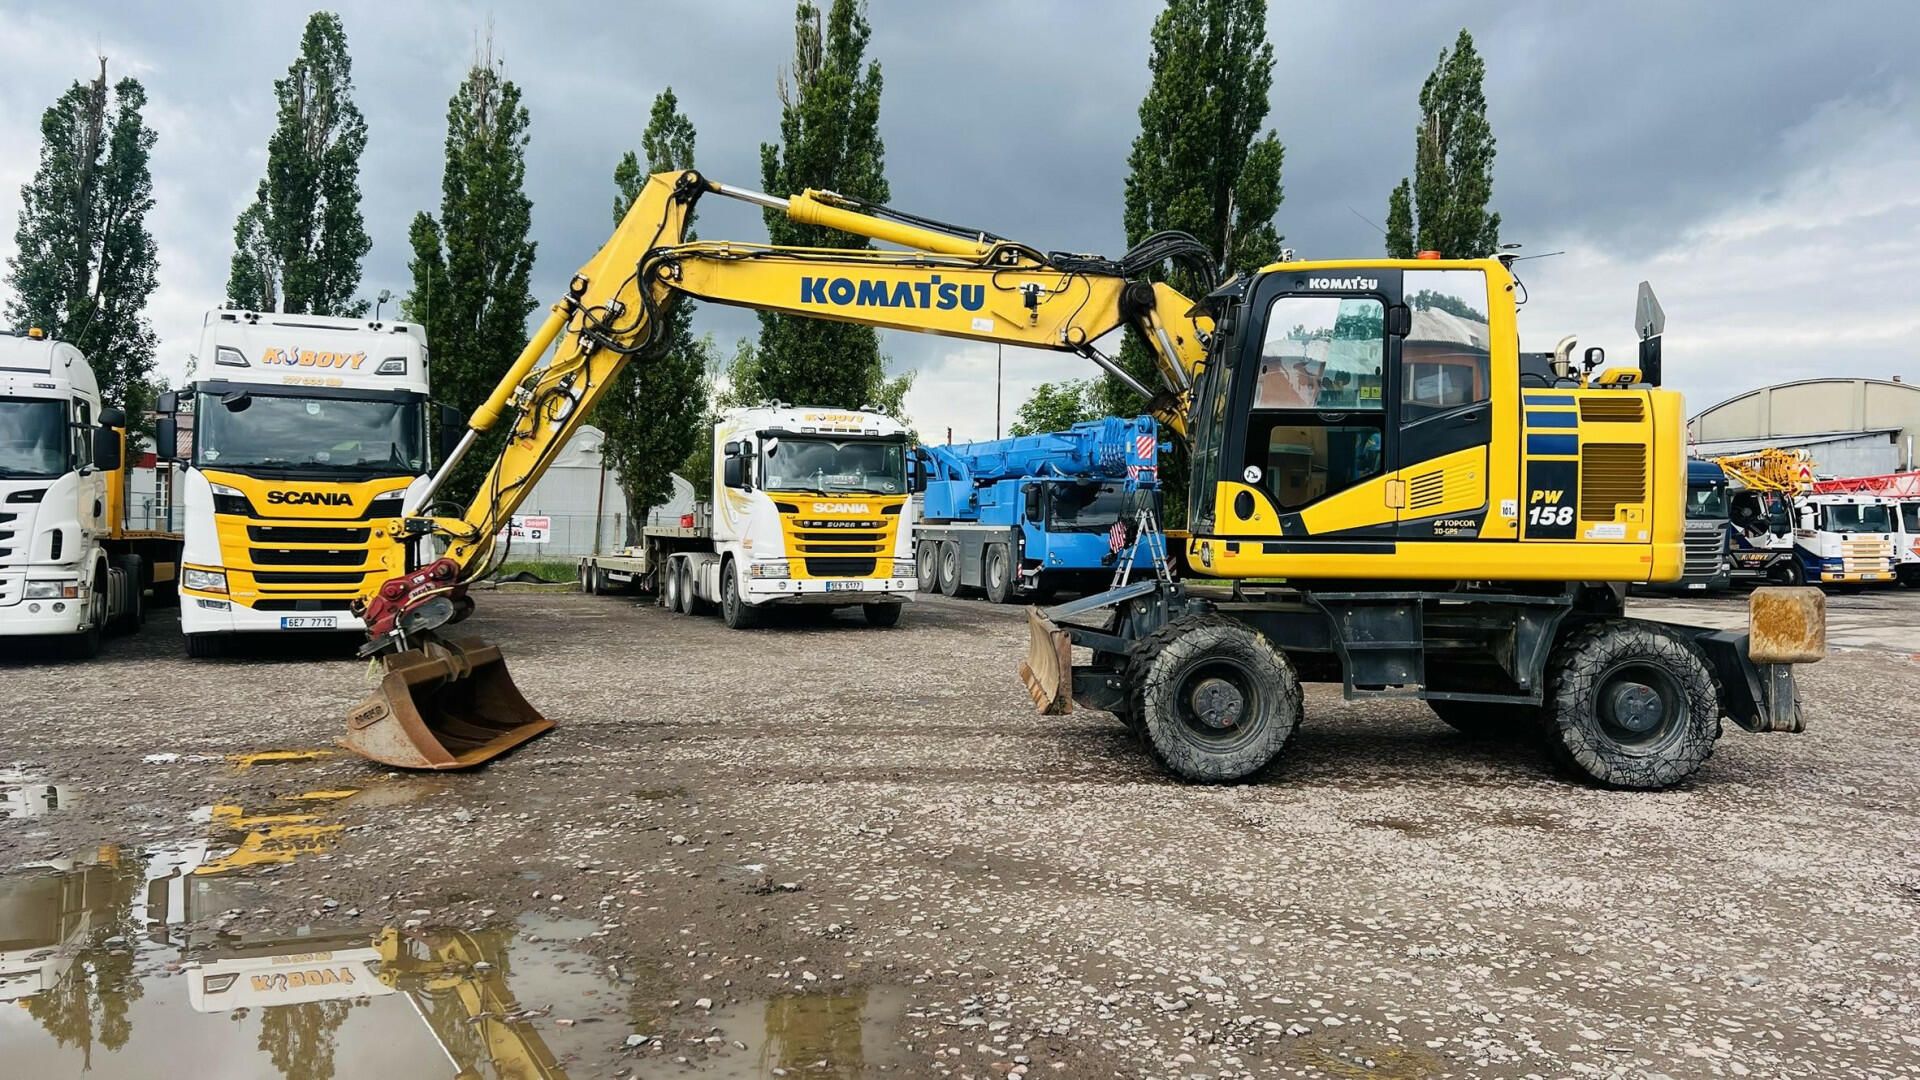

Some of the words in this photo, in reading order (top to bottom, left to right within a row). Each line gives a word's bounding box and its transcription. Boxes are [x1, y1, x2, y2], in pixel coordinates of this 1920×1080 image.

[1309, 276, 1378, 290] KOMATSU
[801, 275, 985, 311] KOMATSU
[267, 490, 353, 506] SCANIA
[1530, 490, 1564, 504] PW
[813, 503, 870, 514] SCANIA
[1443, 519, 1476, 527] TOPCON
[1529, 506, 1574, 526] 158
[288, 618, 305, 627] 6E7
[311, 618, 333, 627] 7712
